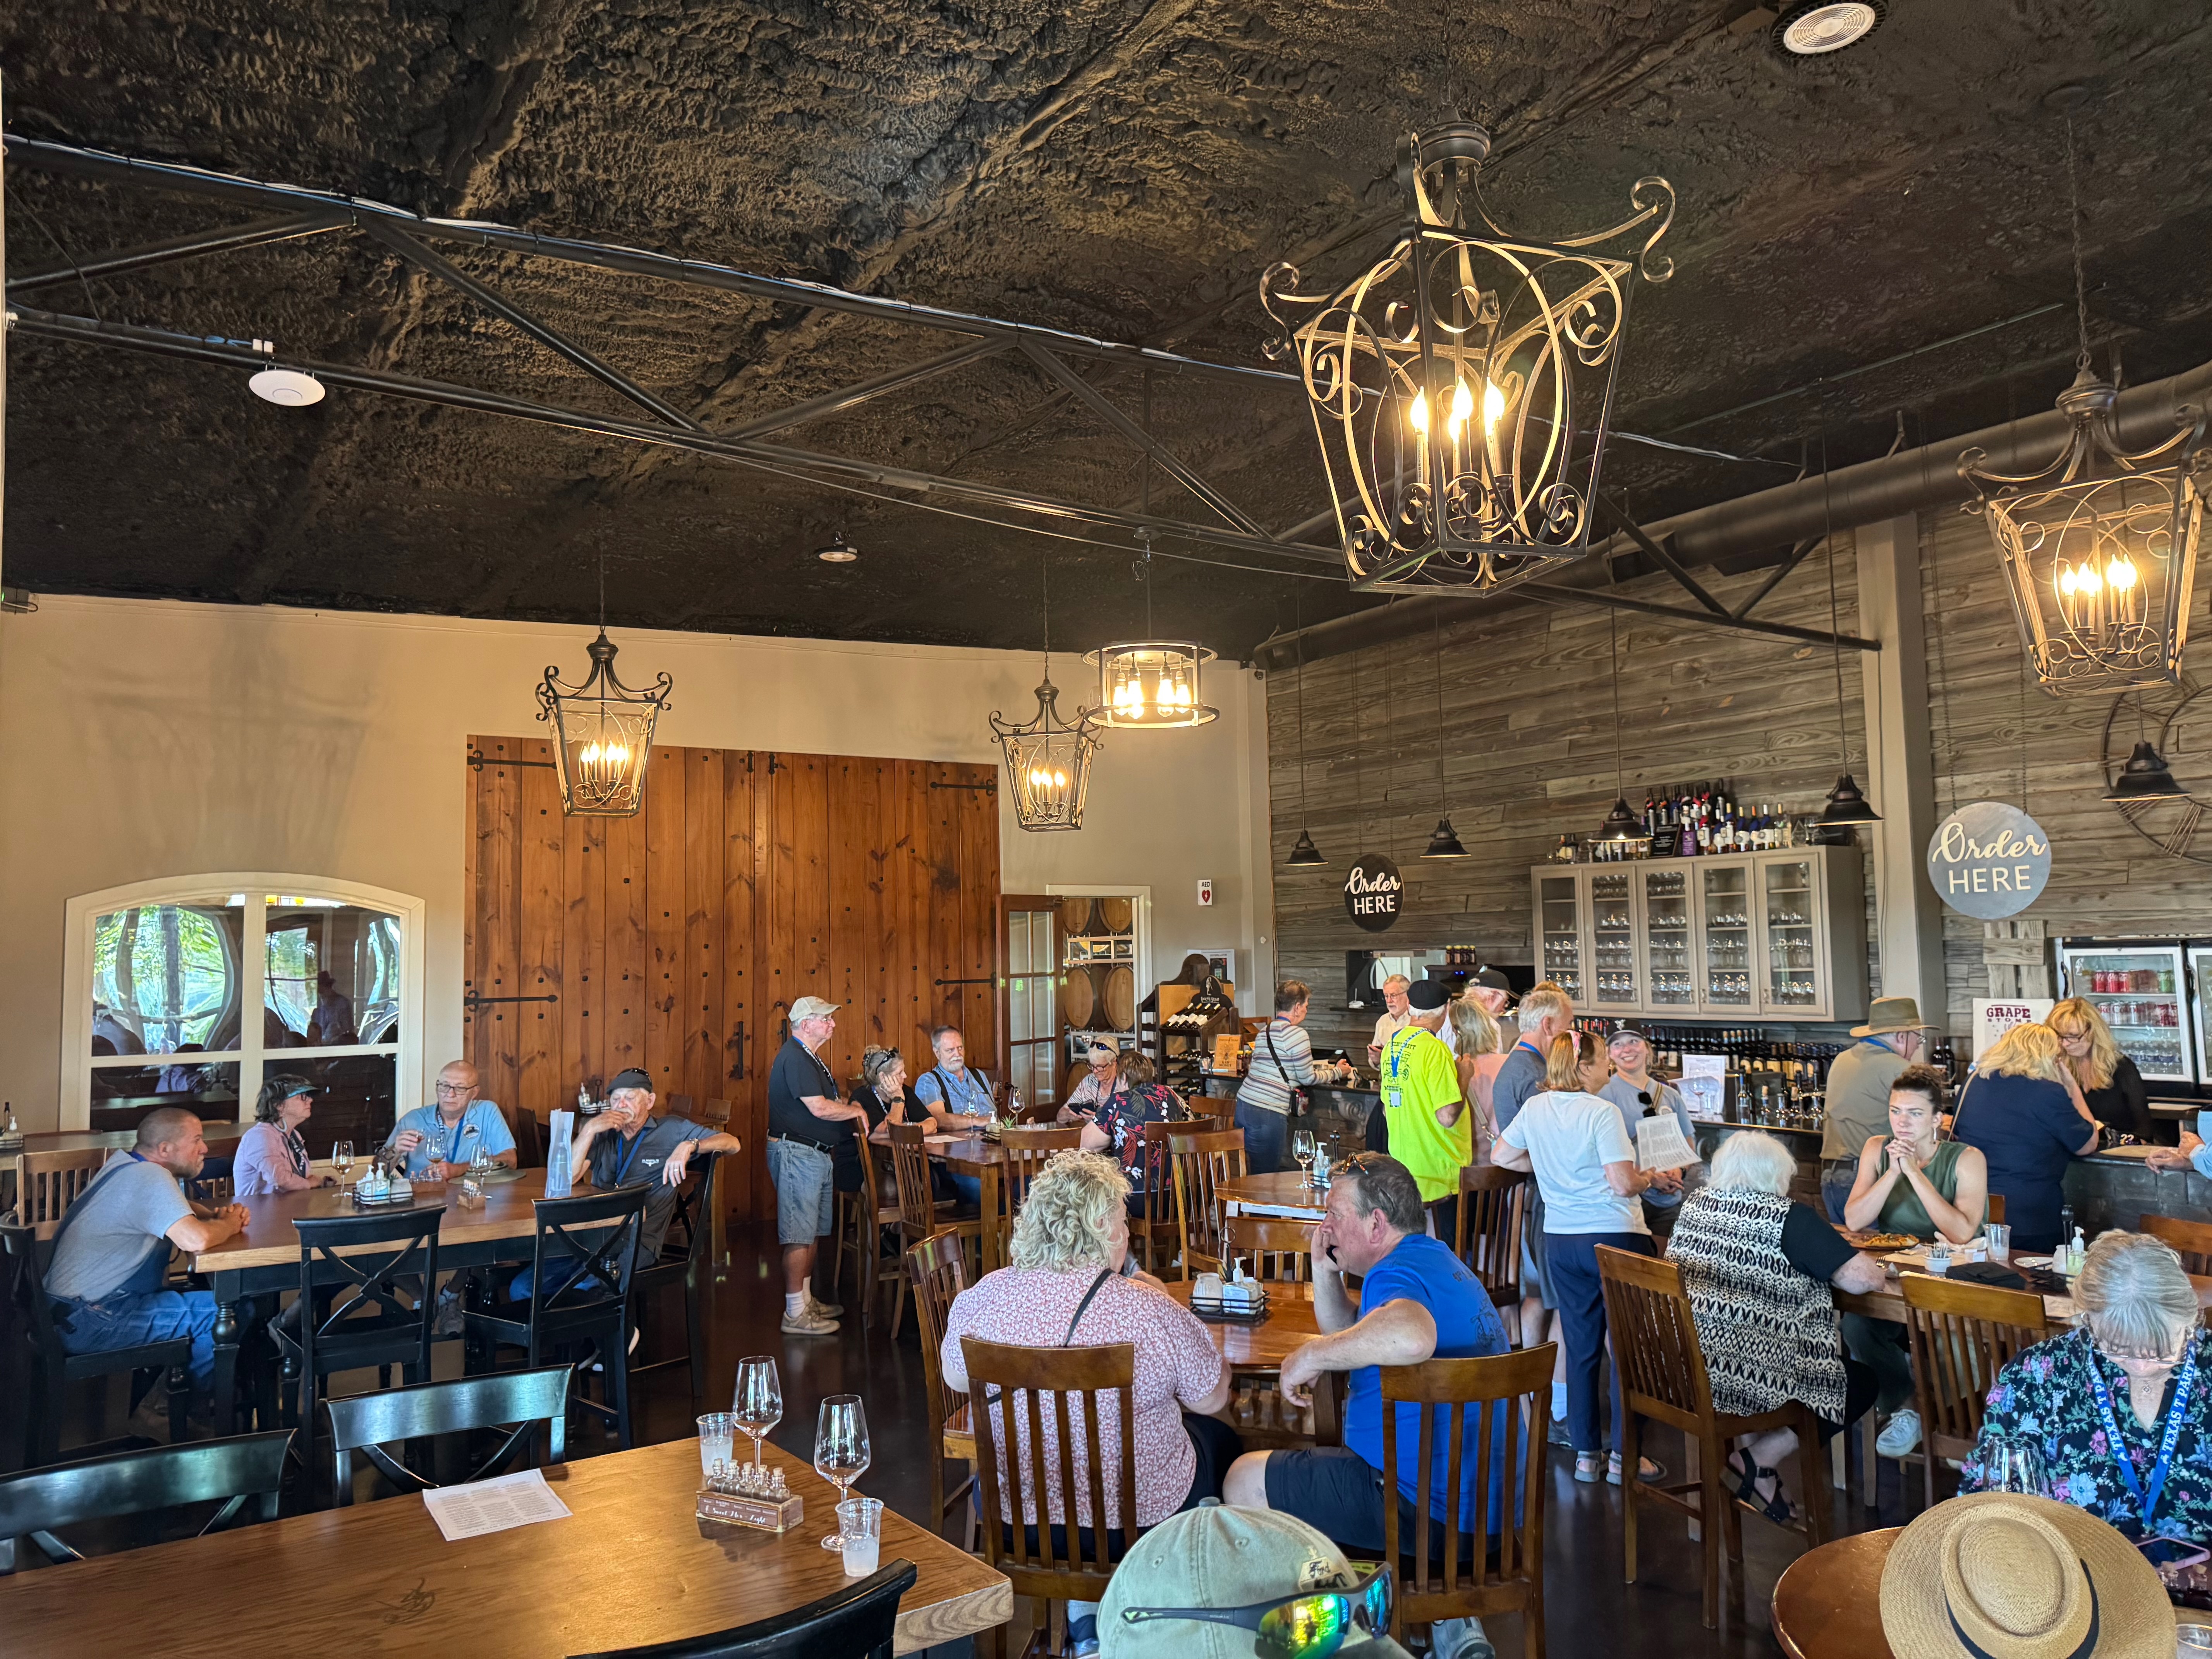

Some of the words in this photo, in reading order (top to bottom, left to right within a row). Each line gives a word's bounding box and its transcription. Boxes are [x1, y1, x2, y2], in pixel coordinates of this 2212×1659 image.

[1932, 823, 2046, 863] Order
[1345, 867, 1401, 894] Order
[1949, 865, 2031, 894] HERE
[1354, 895, 1395, 915] HERE
[1987, 1008, 2031, 1018] GRAPE
[2177, 1354, 2195, 1398] PARTY
[2097, 1395, 2107, 1405] T
[2174, 1398, 2185, 1408] T
[2100, 1407, 2123, 1450] TEXAS
[2162, 1411, 2182, 1452] TEXAS
